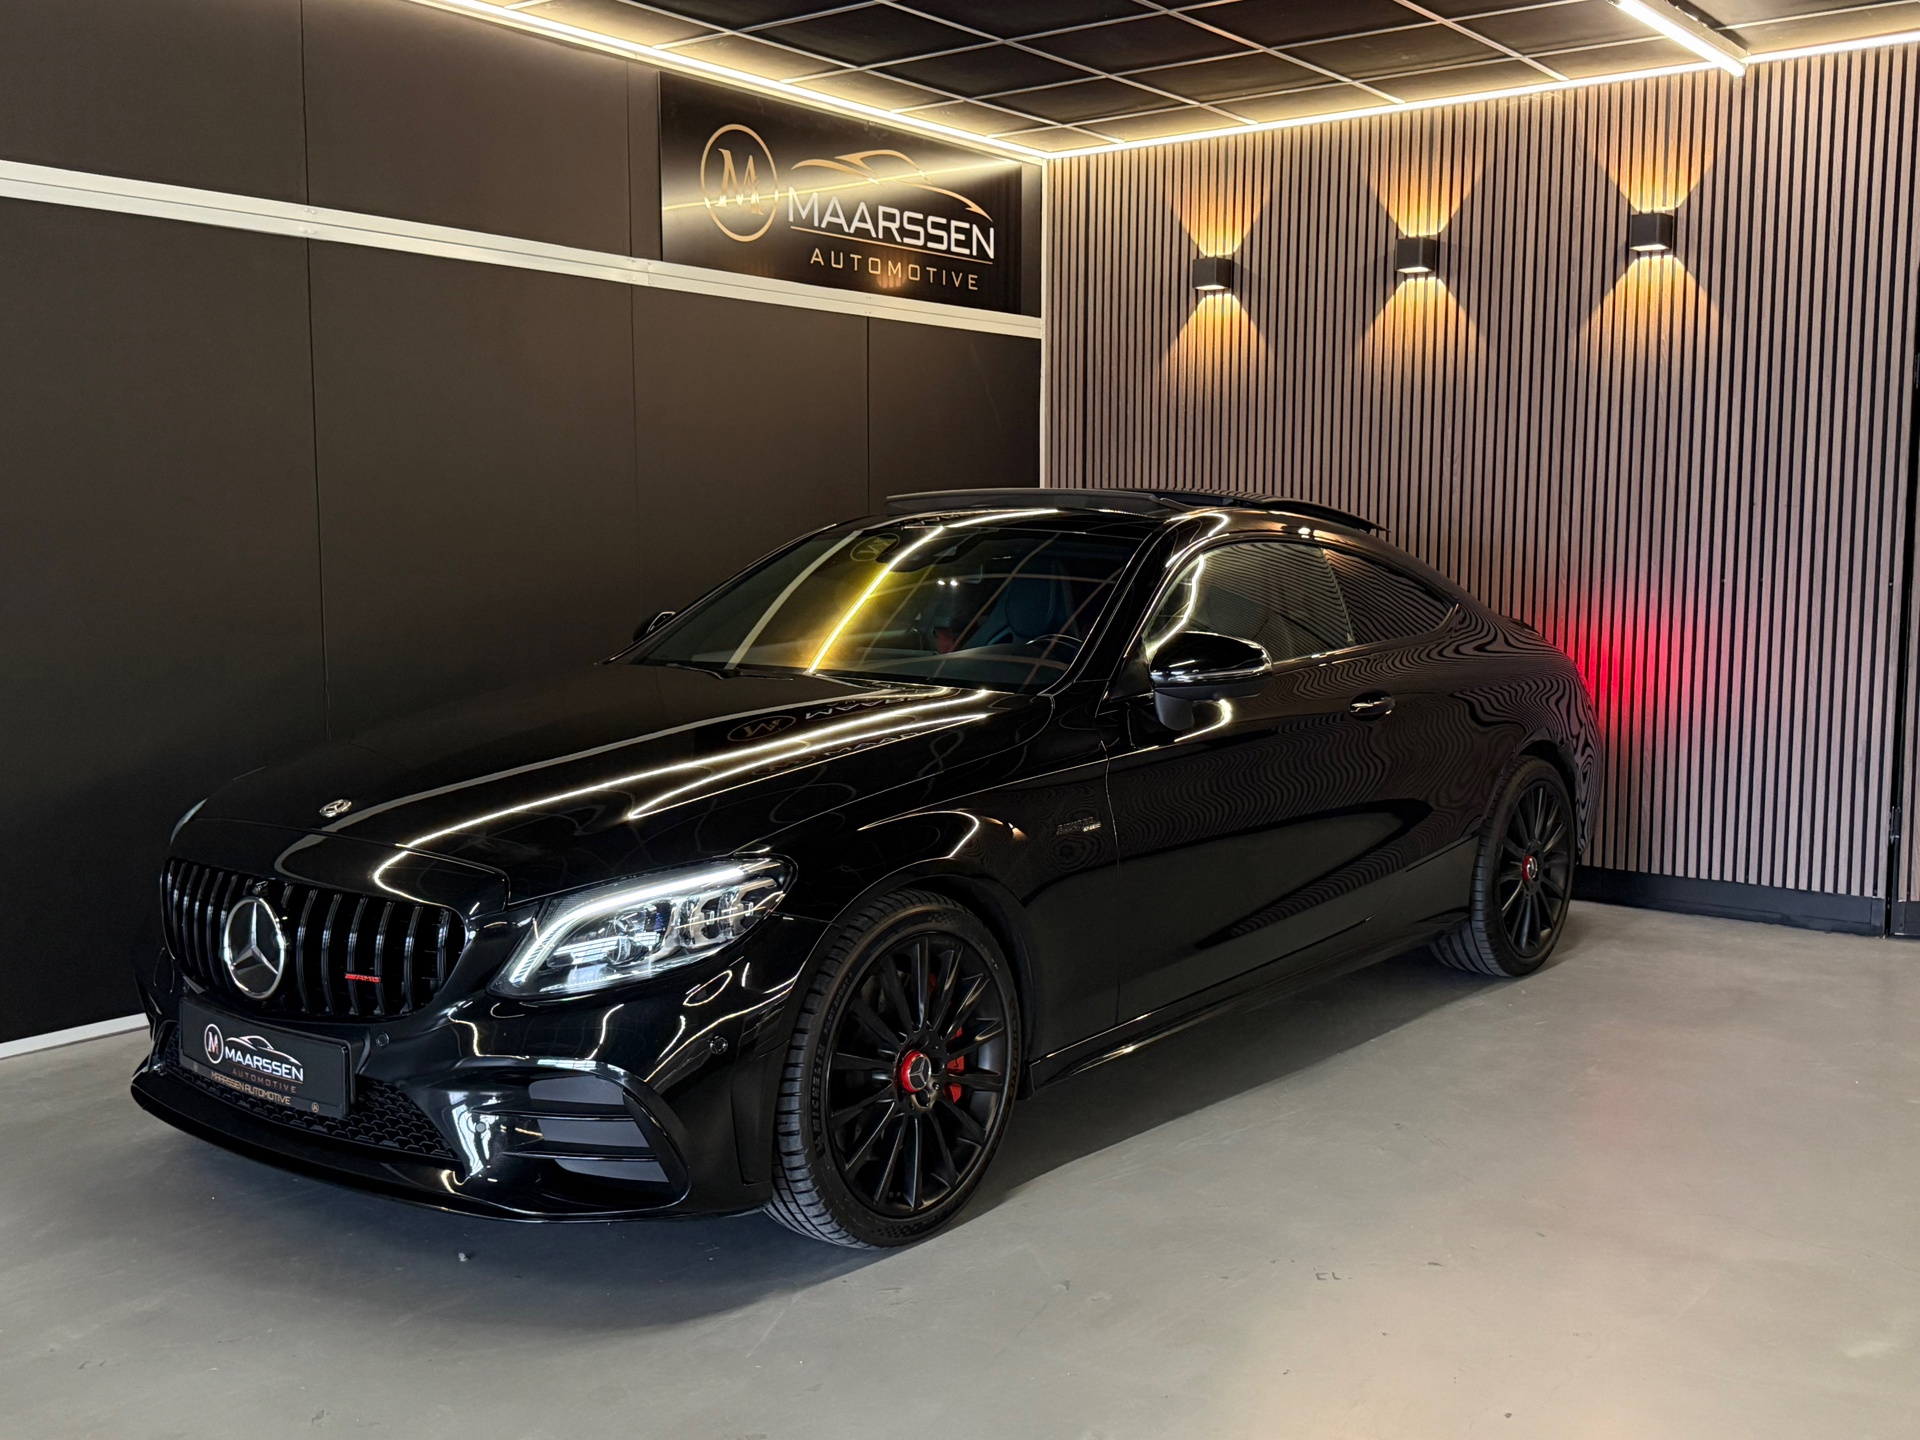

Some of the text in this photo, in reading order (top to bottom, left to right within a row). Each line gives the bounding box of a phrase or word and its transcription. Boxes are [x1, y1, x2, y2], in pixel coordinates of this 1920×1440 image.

[788, 186, 995, 260] MAARSSEN
[810, 248, 979, 291] AUTOMOTIVE
[354, 974, 380, 983] AMG
[225, 1046, 303, 1081] MAARSSEN
[232, 1068, 297, 1093] AUTOMOTIVE
[244, 1084, 292, 1105] AUTOMOTIVE
